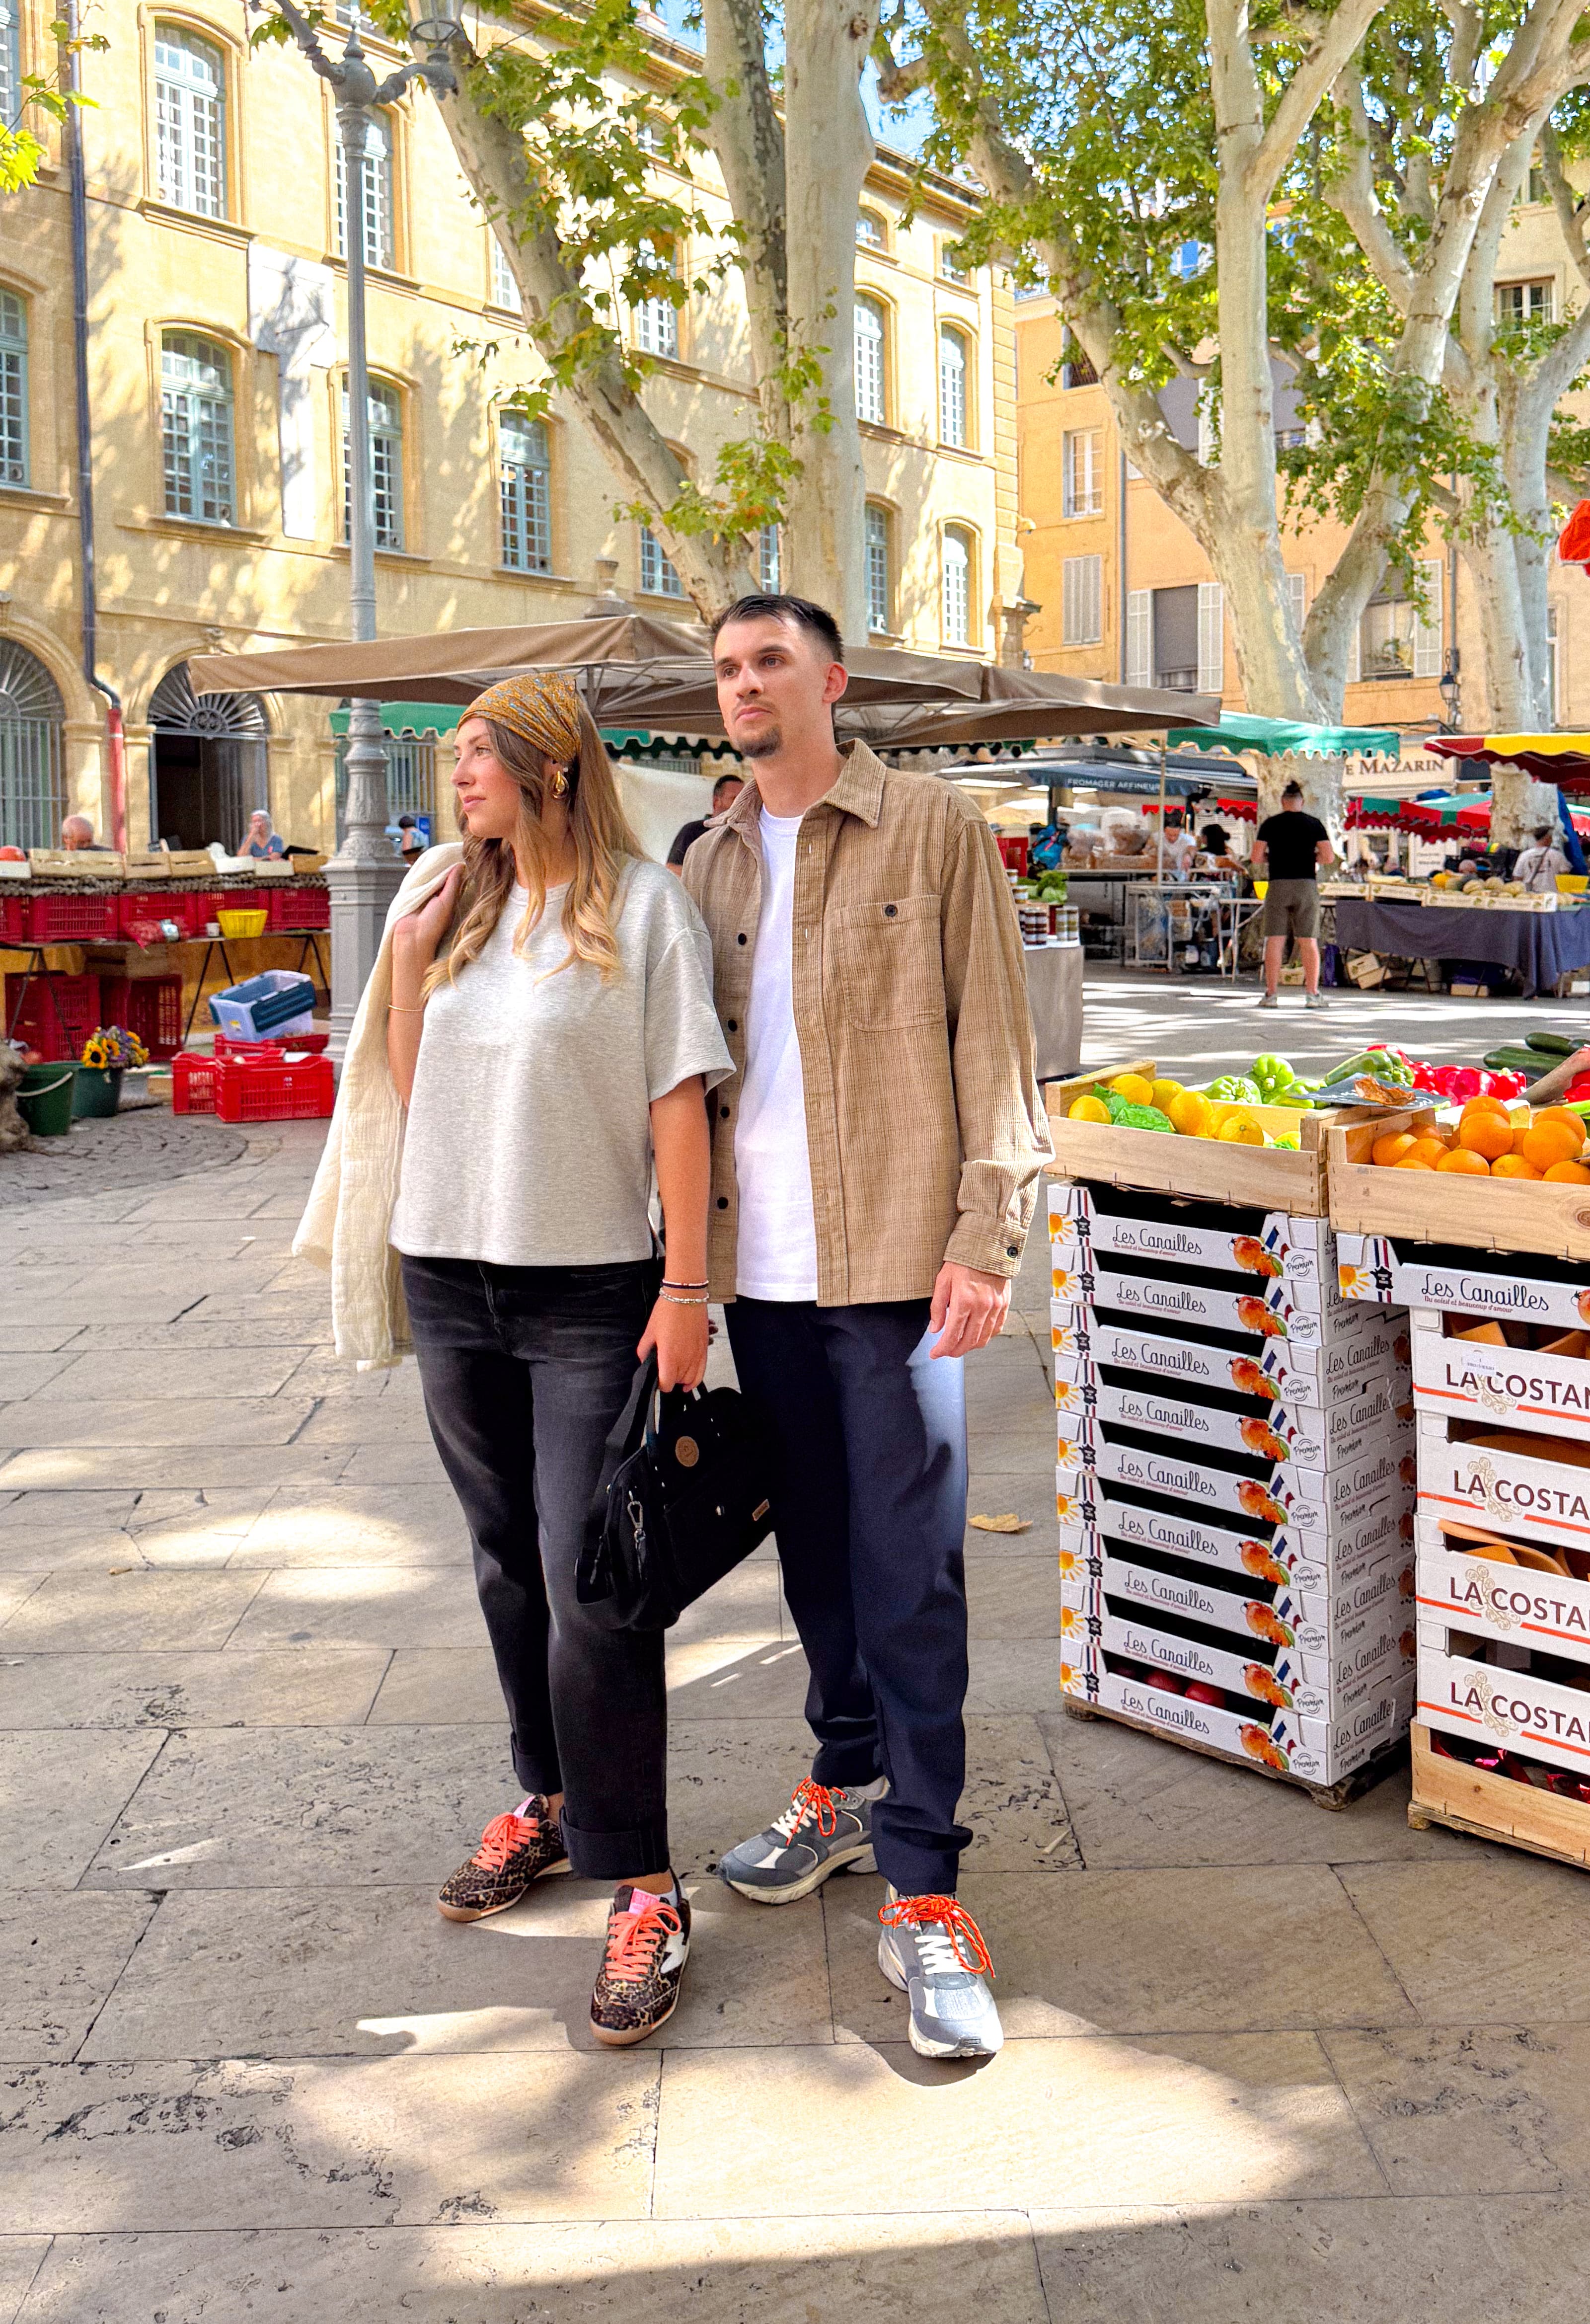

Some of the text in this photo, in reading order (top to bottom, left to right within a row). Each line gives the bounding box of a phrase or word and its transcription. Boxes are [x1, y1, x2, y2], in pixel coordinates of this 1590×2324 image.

[1067, 778, 1115, 788] FROMAGER
[1359, 759, 1444, 774] MAZARIN
[1113, 1225, 1136, 1244] Les
[1140, 1229, 1202, 1254] Canailles
[1324, 1224, 1336, 1246] Le
[1117, 1281, 1139, 1301] Les
[1144, 1285, 1206, 1313] Canailles
[1421, 1273, 1549, 1311] Les Canailles
[1458, 1300, 1487, 1311] beaucoup
[1112, 1338, 1136, 1360] Les
[1141, 1343, 1209, 1375] Canailles
[1326, 1352, 1344, 1375] Les
[1348, 1335, 1389, 1366] Canailles
[1446, 1364, 1479, 1390] LA
[1119, 1395, 1142, 1416] Les
[1146, 1400, 1209, 1431] Canailles
[1330, 1412, 1347, 1435] Les
[1350, 1393, 1390, 1425] Canaille
[1118, 1454, 1143, 1477] Les
[1148, 1461, 1216, 1496] Canailles
[1333, 1479, 1351, 1502] Les
[1354, 1457, 1395, 1491] Canailles
[1454, 1470, 1486, 1498] LA
[1118, 1511, 1144, 1535] Les
[1149, 1519, 1218, 1555] Canailles
[1335, 1539, 1352, 1561] Les
[1356, 1516, 1395, 1550] Canailles
[1125, 1571, 1147, 1593] Les
[1151, 1578, 1214, 1614] Canailles
[1334, 1598, 1351, 1621] Les
[1354, 1572, 1395, 1608] Canailles
[1450, 1577, 1590, 1632] LA COSTA
[1124, 1630, 1146, 1653] Les
[1151, 1639, 1213, 1675] Canailles
[1336, 1661, 1353, 1685] Les
[1355, 1633, 1396, 1671] Canailles
[1121, 1688, 1143, 1711] Les
[1147, 1698, 1210, 1734] Canailles
[1451, 1682, 1590, 1743] LA COSTA
[1333, 1727, 1351, 1750] Les
